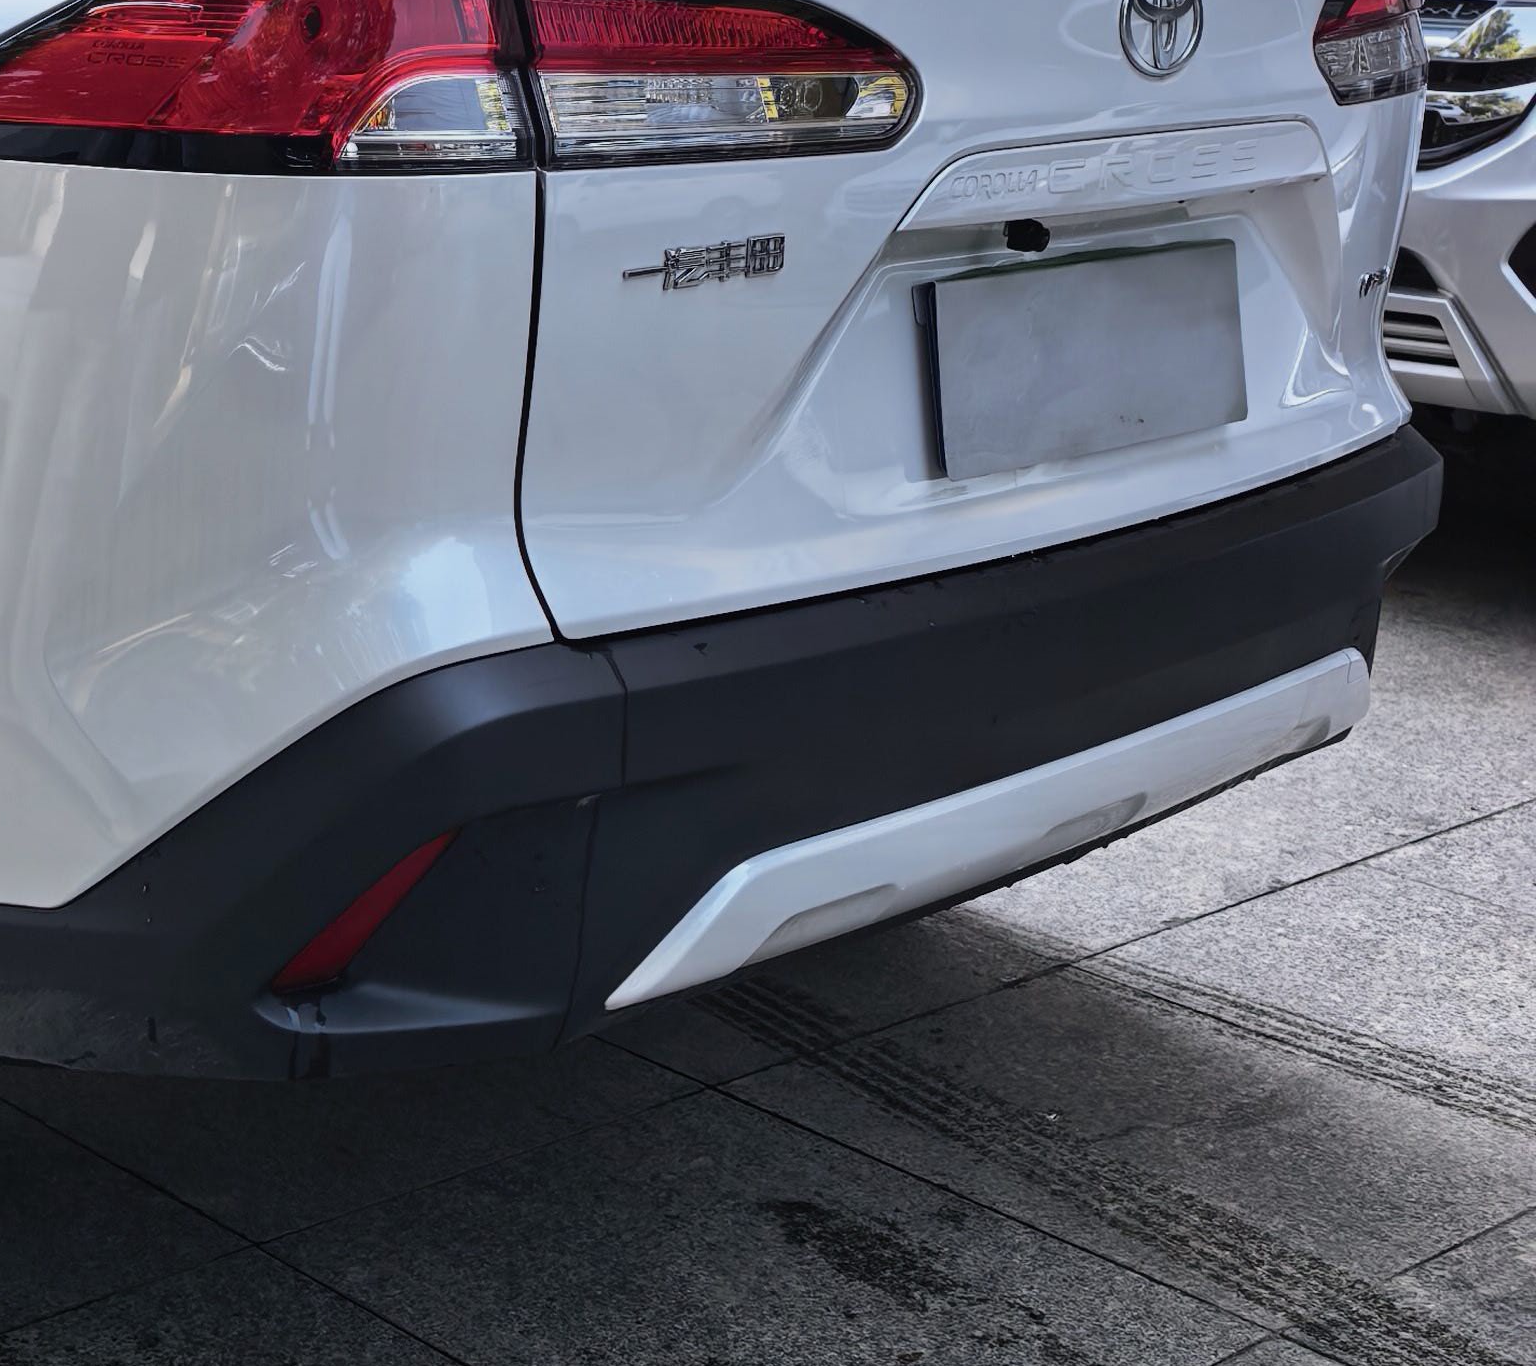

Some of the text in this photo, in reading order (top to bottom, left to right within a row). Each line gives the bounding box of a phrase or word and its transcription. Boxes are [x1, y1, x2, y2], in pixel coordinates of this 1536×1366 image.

[87, 51, 187, 67] CROSS
[950, 138, 1259, 201] COROLLA CROSS
[622, 232, 786, 291] 一汽丰田
